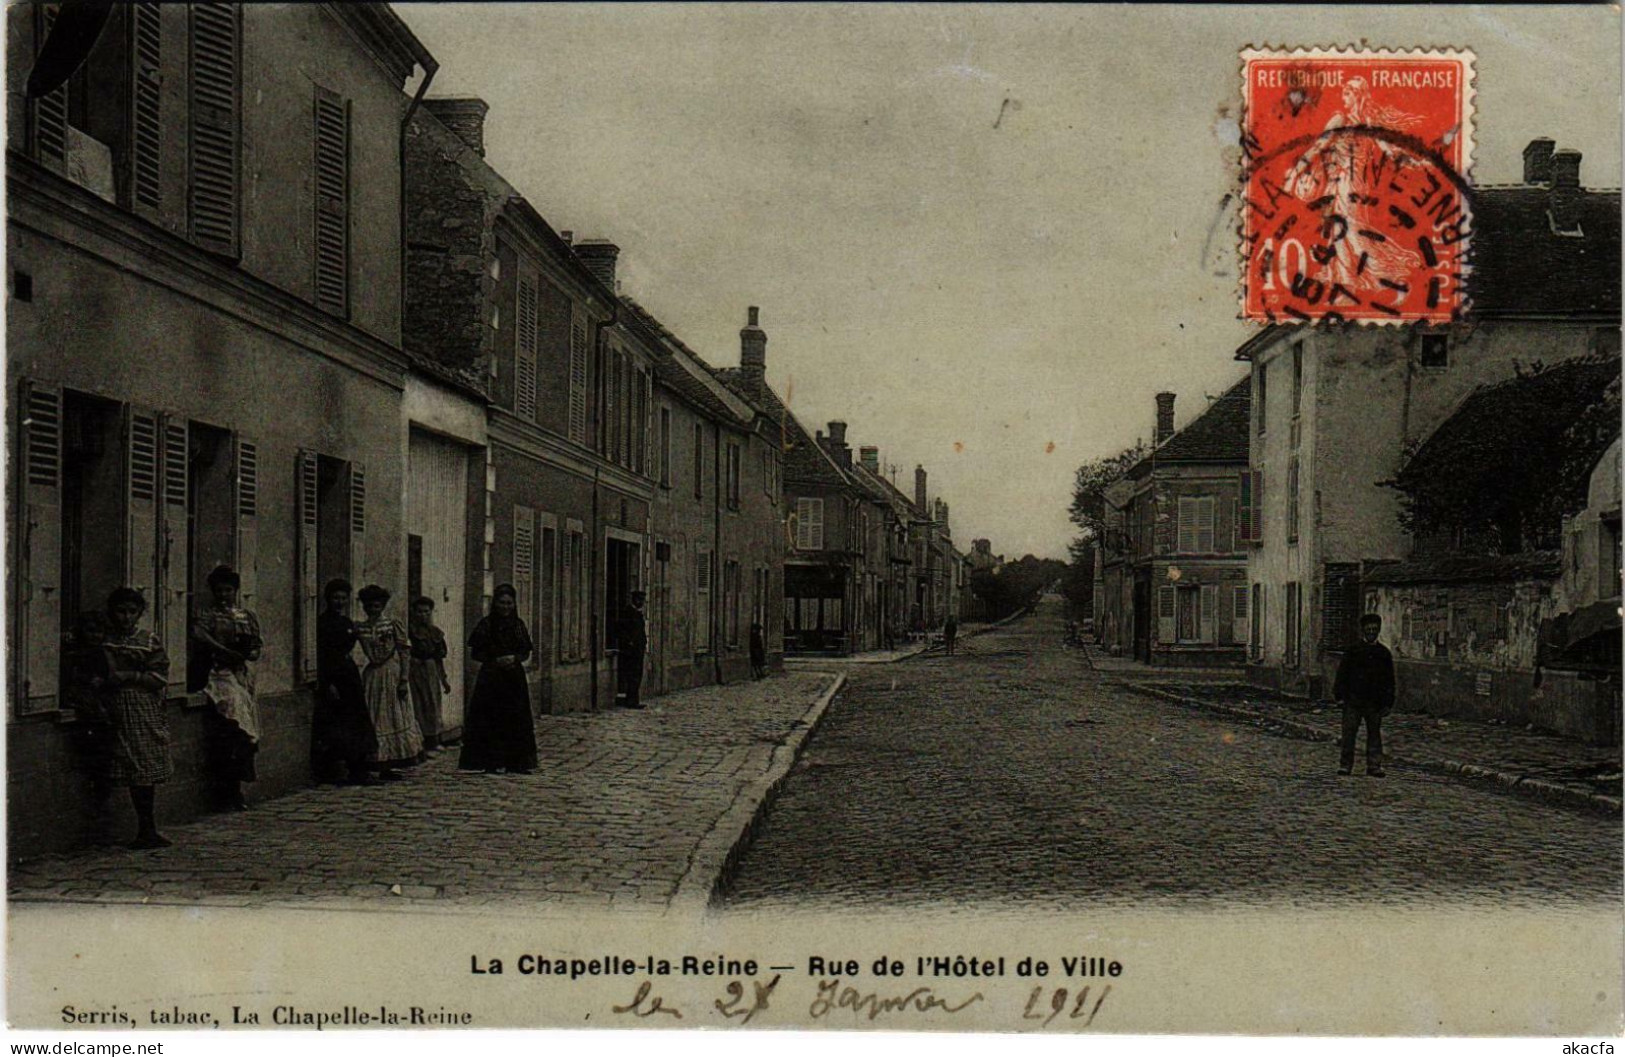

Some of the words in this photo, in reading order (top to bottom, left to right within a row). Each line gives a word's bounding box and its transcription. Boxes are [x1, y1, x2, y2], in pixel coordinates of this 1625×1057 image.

[1371, 69, 1454, 88] FRANÇAISE
[1256, 238, 1307, 291] 10
[470, 954, 503, 976] La
[517, 954, 759, 981] Chapelle-la-Reine
[807, 955, 860, 977] Rue
[871, 955, 905, 977] de
[916, 954, 1006, 977] l'Hôtel
[1015, 955, 1050, 977] de
[1060, 955, 1124, 978] Ville
[612, 980, 683, 1020] le
[61, 1004, 137, 1029] Serris,
[149, 1004, 220, 1030] tabac,
[231, 1005, 261, 1026] La
[271, 1004, 474, 1031] Chapelle-la-Reine
